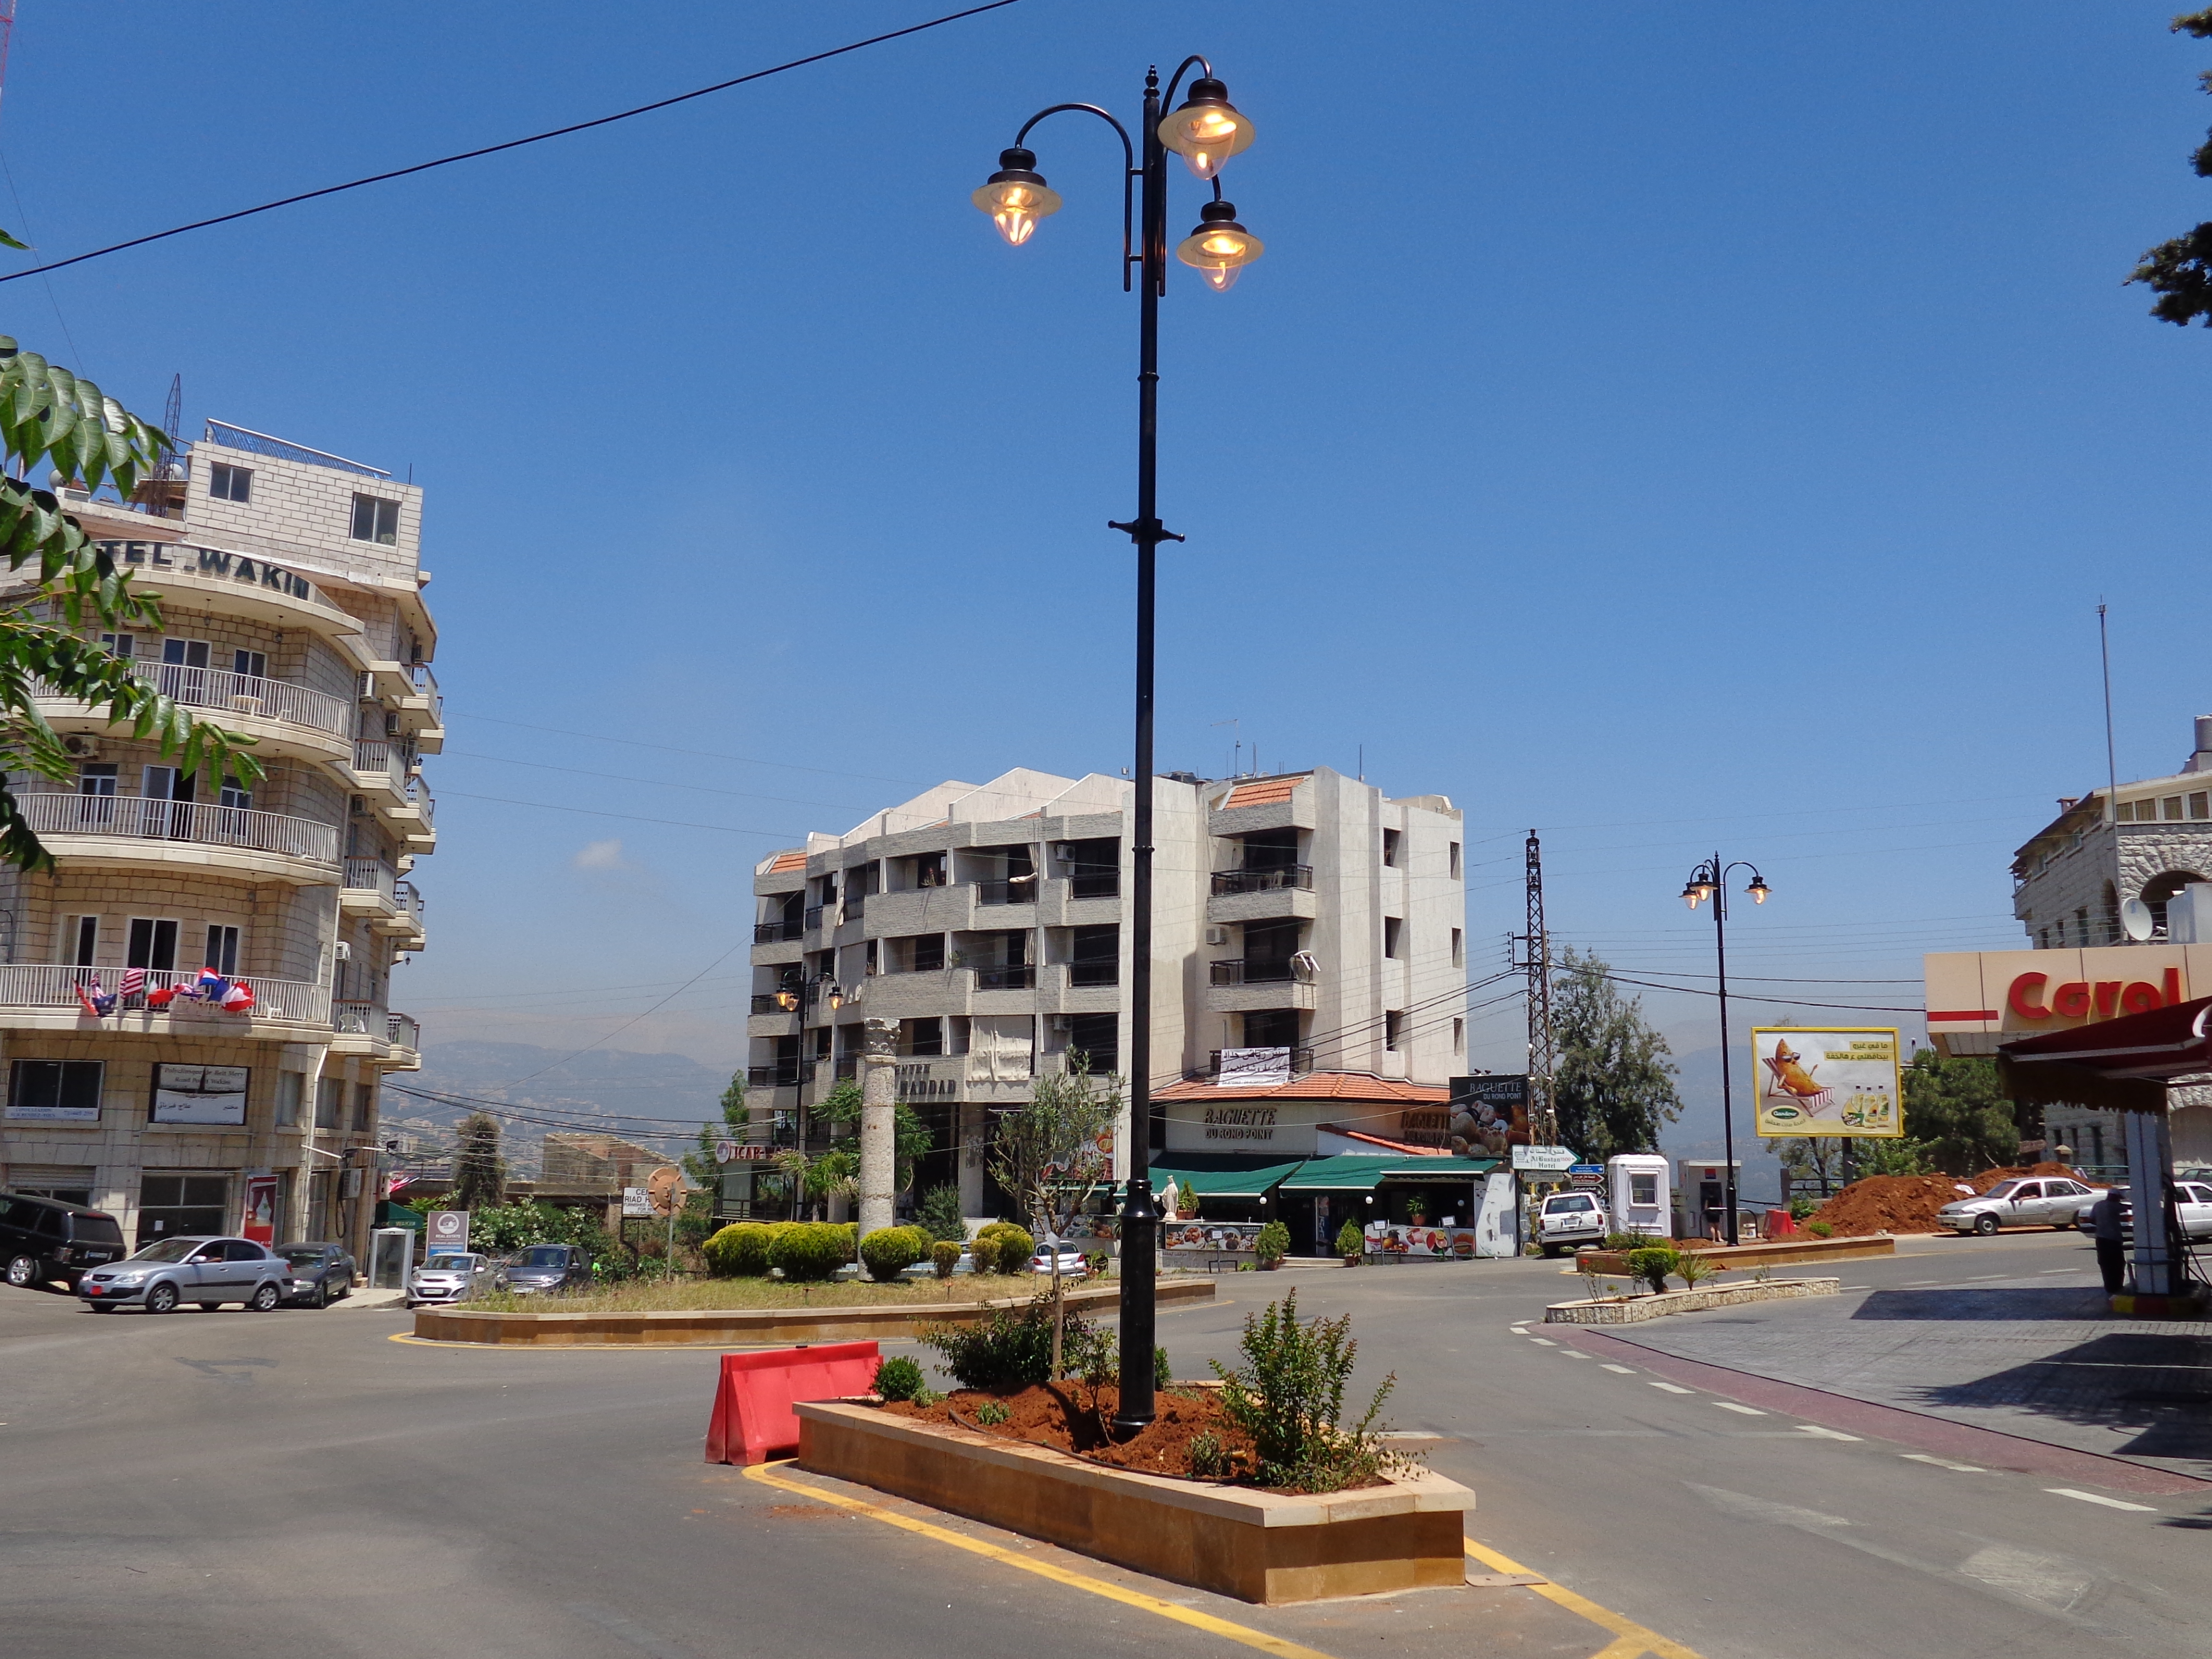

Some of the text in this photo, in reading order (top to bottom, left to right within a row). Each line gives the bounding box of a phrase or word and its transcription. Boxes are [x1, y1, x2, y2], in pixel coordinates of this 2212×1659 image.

[199, 548, 310, 600] WAKIM
[2009, 968, 2180, 1019] Coral
[1243, 1049, 1265, 1059] رياض
[895, 1064, 930, 1074] ENTRE
[901, 1080, 956, 1095] HADDAD
[1470, 1082, 1521, 1093] BAGUETTE
[1204, 1109, 1277, 1126] BAGUETTE
[1206, 1129, 1273, 1140] DU ROND POINT
